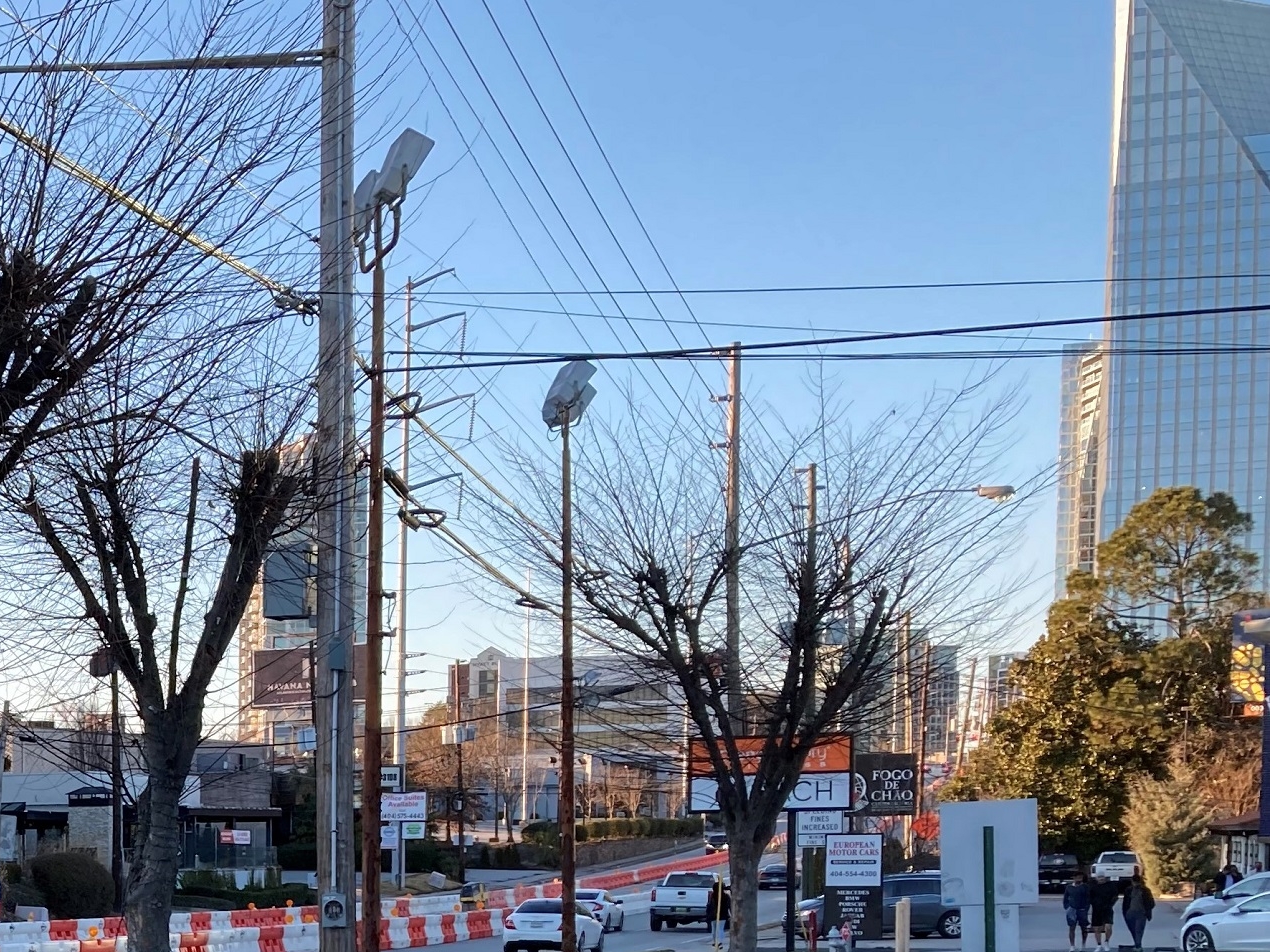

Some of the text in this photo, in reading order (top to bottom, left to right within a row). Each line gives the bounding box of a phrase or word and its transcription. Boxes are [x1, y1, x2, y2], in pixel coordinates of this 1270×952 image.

[267, 681, 303, 692] HAVANA
[872, 769, 914, 781] FOGO
[884, 780, 900, 790] DE
[802, 823, 839, 831] INCREASED
[833, 841, 876, 849] EUROPEAN
